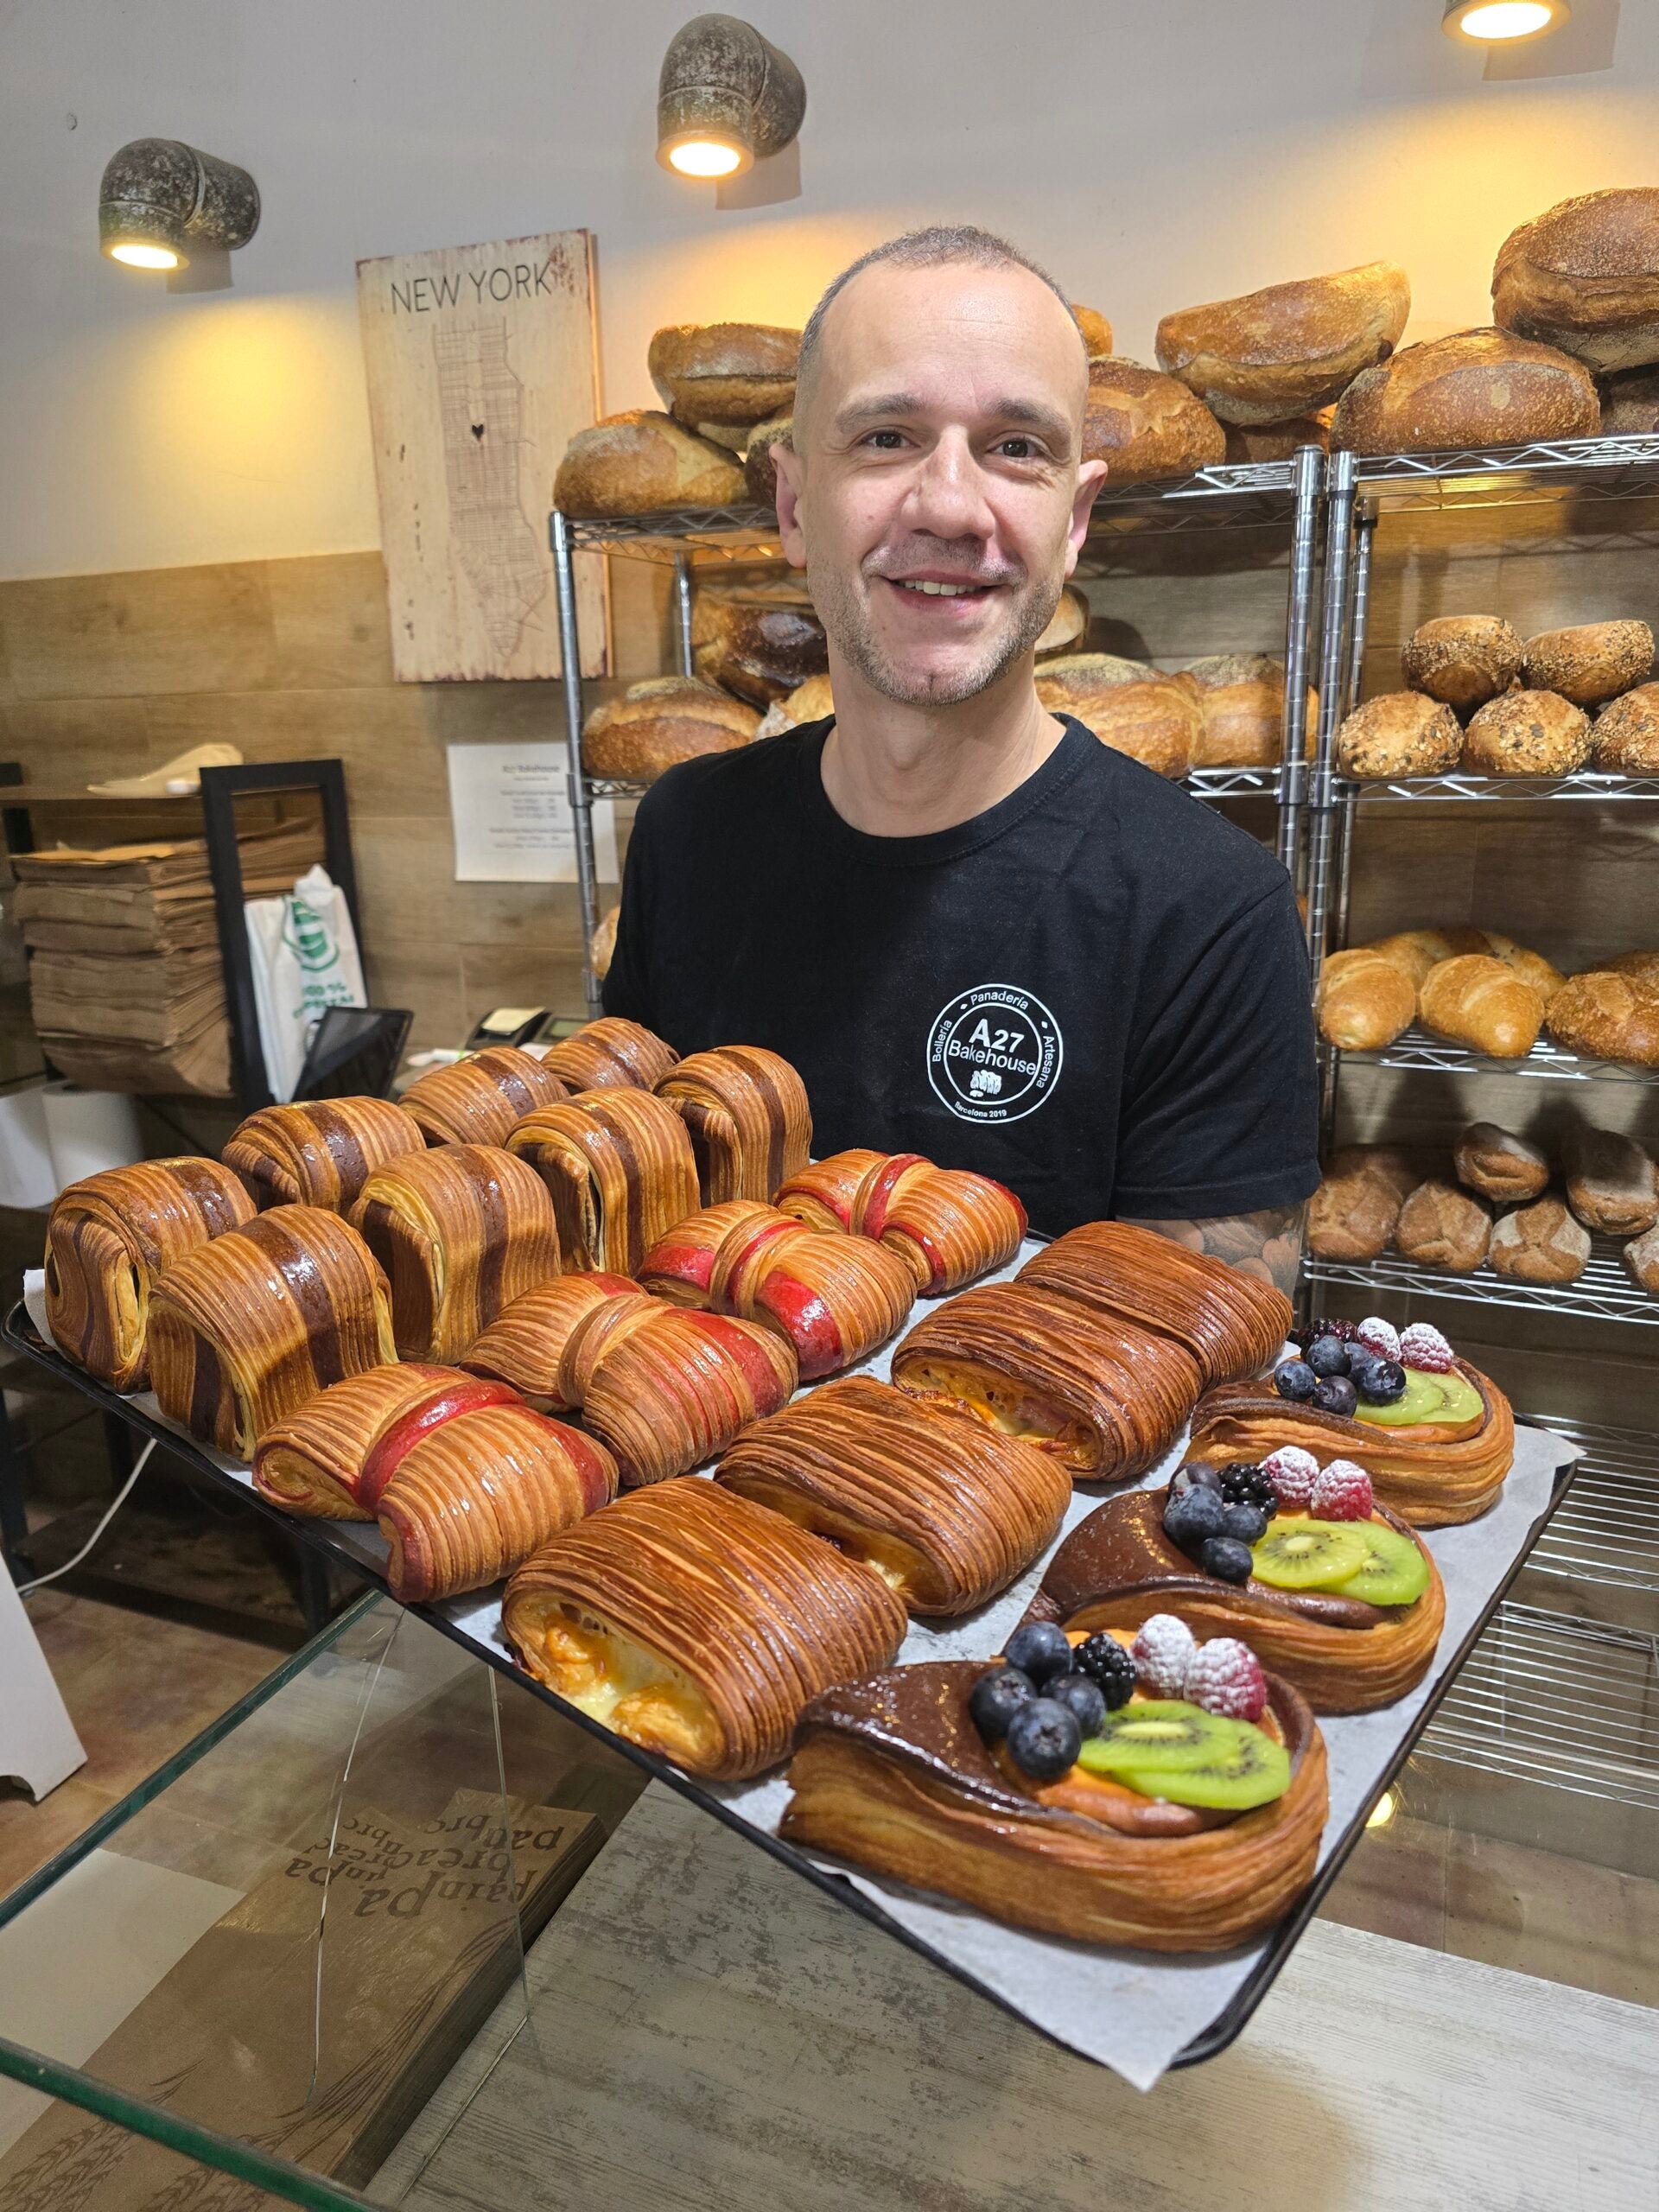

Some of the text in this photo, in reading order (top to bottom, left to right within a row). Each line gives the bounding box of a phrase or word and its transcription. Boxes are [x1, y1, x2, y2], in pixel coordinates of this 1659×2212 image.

[391, 262, 552, 315] NEW YORK
[970, 991, 1028, 1010] Panadería
[932, 1020, 952, 1062] Bollería
[969, 1018, 1025, 1053] A27
[948, 1039, 1036, 1076] Bakehouse
[1036, 1036, 1055, 1089] Artesana
[955, 1101, 988, 1118] Barcelona
